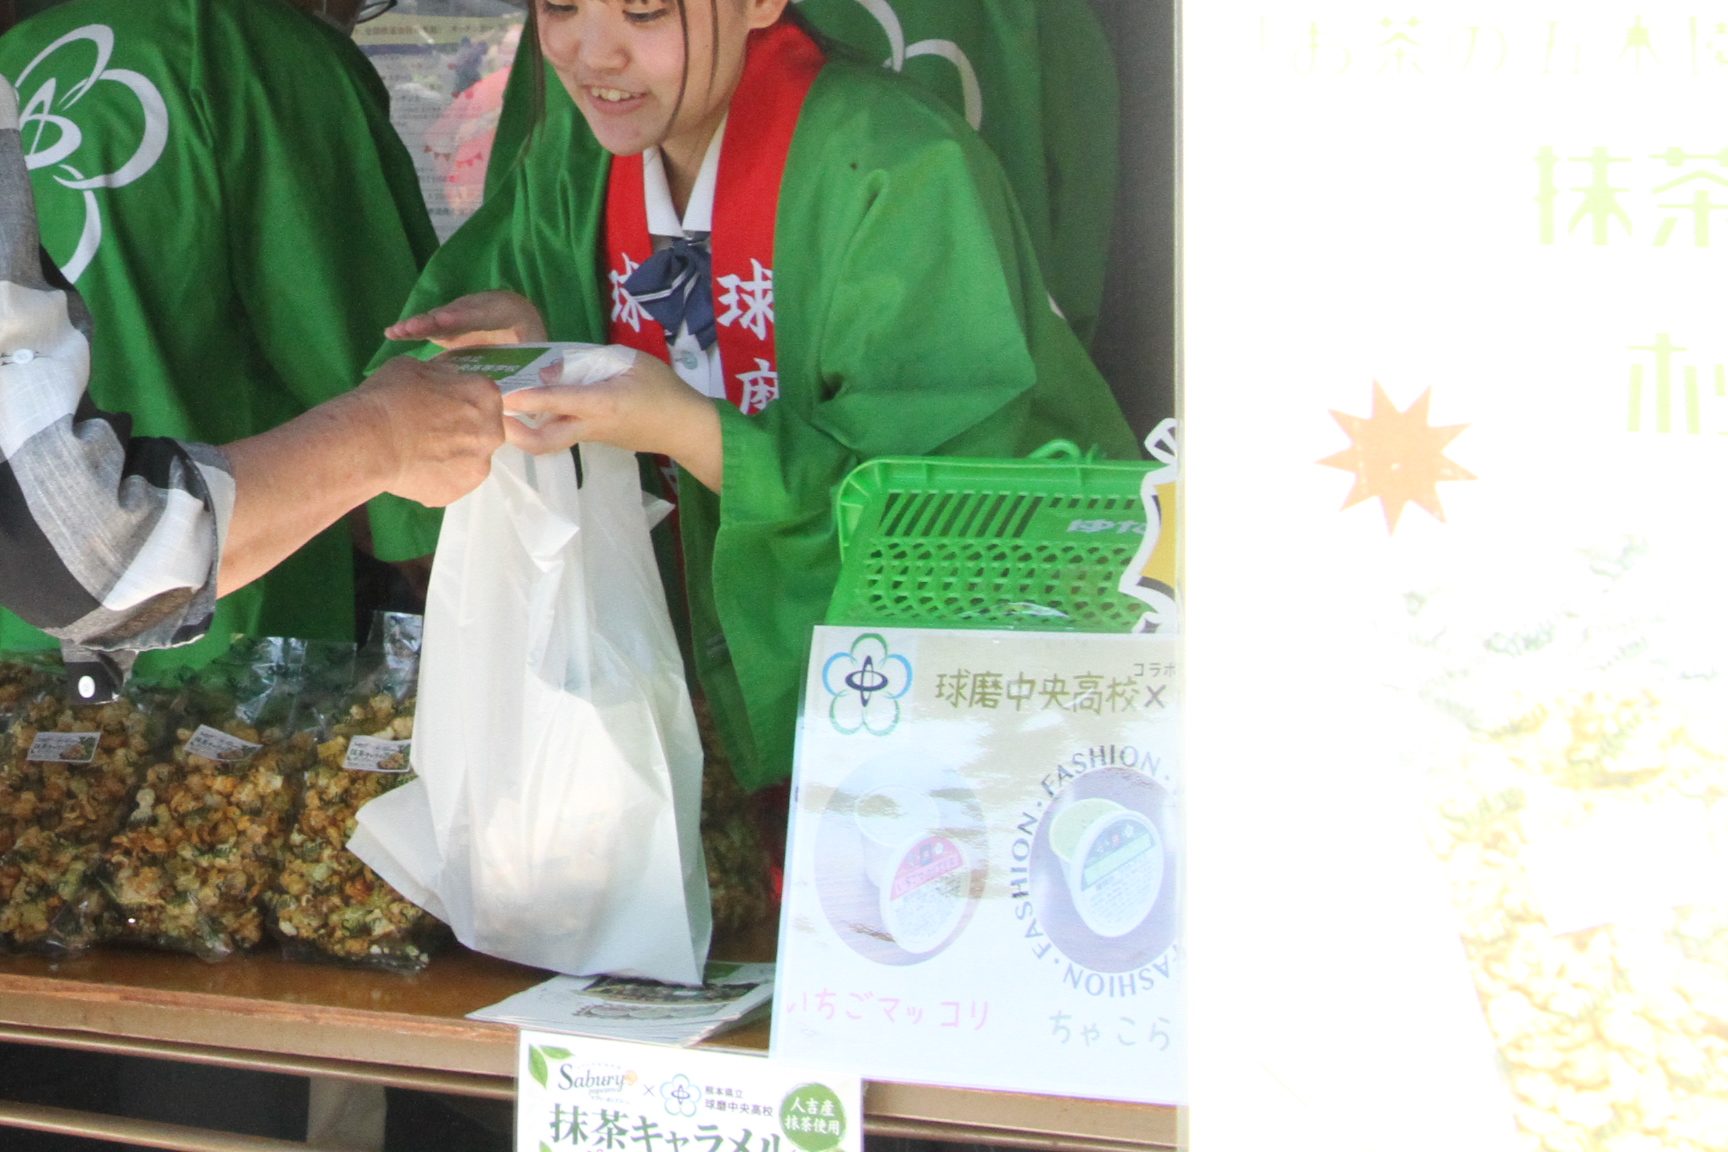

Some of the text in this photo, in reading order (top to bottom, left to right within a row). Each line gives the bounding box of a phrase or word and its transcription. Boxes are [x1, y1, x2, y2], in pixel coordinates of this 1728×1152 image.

[1532, 145, 1728, 248] 抹茶
[1039, 743, 1162, 799] FASHION
[1010, 810, 1052, 961] FASHION
[785, 986, 990, 1031] いちごマッコリ
[1048, 1009, 1171, 1052] ちゃこら
[557, 1062, 626, 1093] Sabury
[704, 1085, 744, 1099] 熊本県立
[704, 1098, 774, 1118] 球磨中央高校
[785, 1114, 841, 1136] 抹茶使用
[789, 1096, 836, 1117] 人吉産
